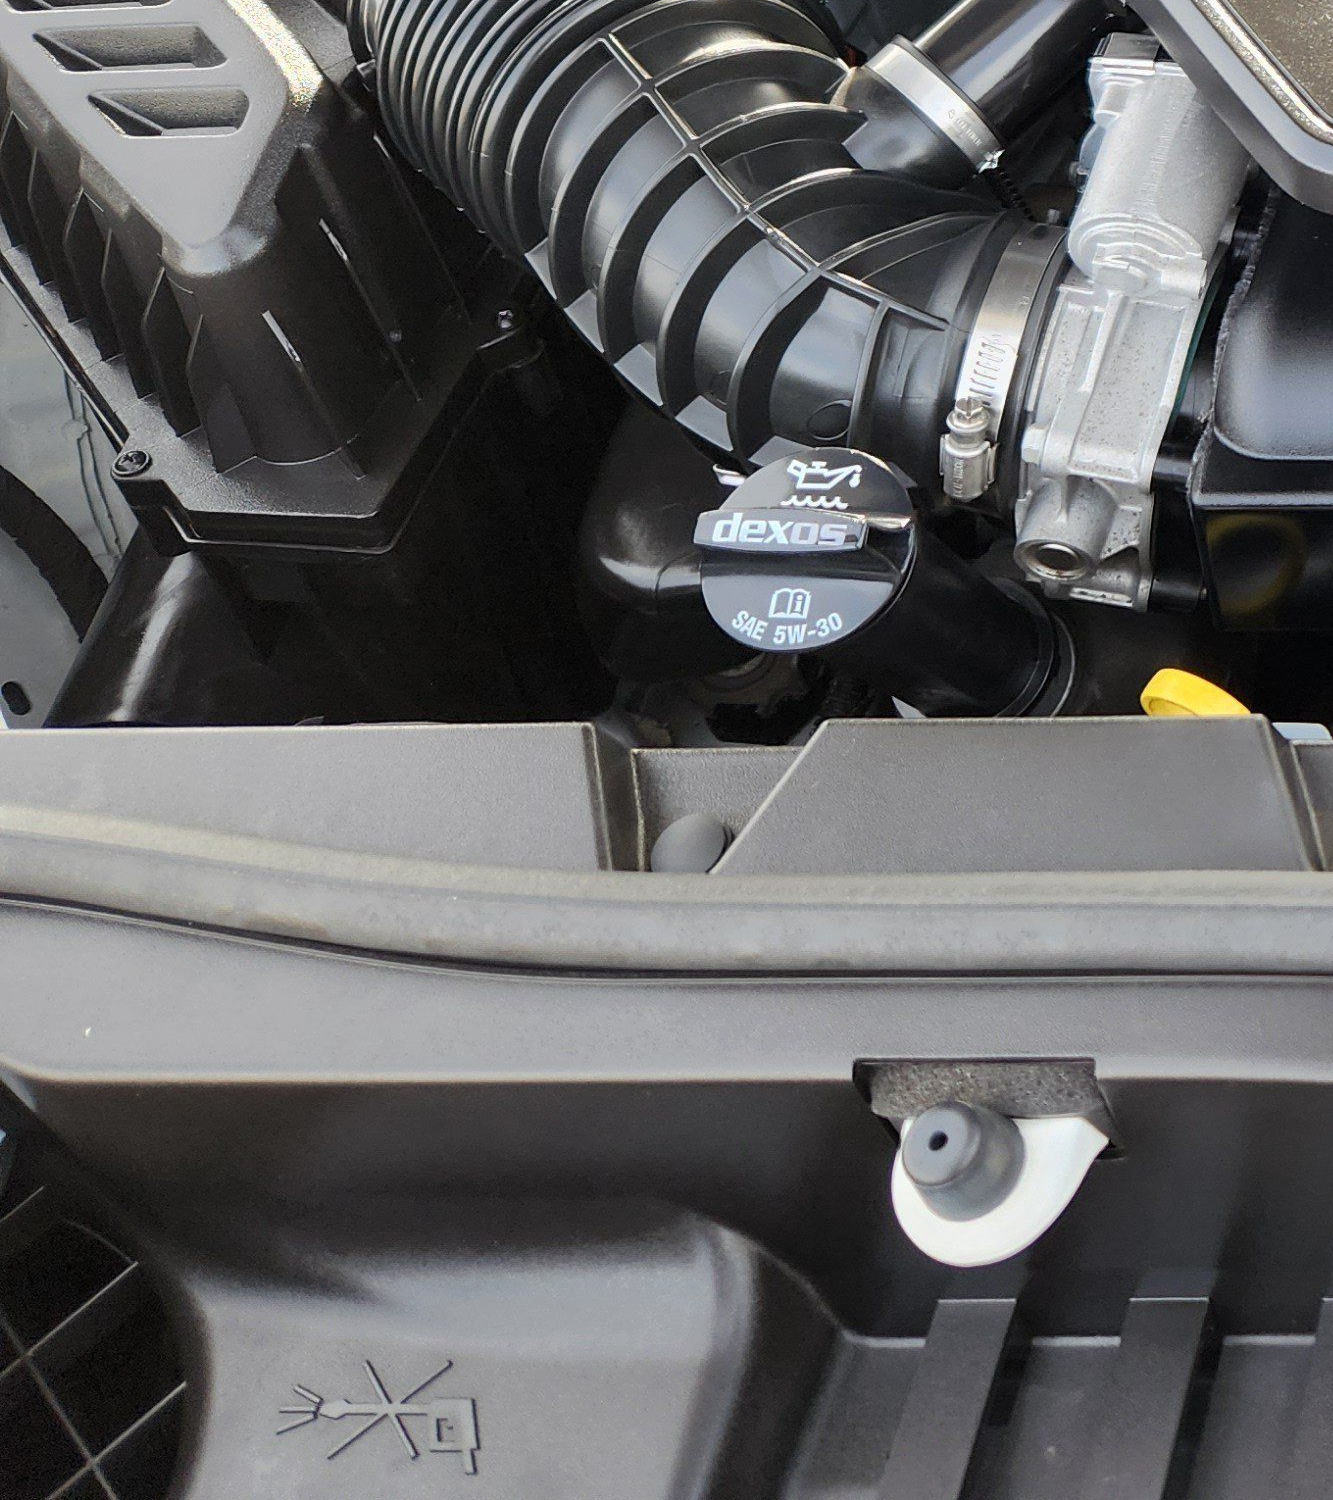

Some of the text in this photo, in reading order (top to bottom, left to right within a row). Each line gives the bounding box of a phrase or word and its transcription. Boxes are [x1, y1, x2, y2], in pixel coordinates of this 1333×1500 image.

[711, 512, 848, 546] dexos
[731, 610, 843, 645] SAE 5W-30
